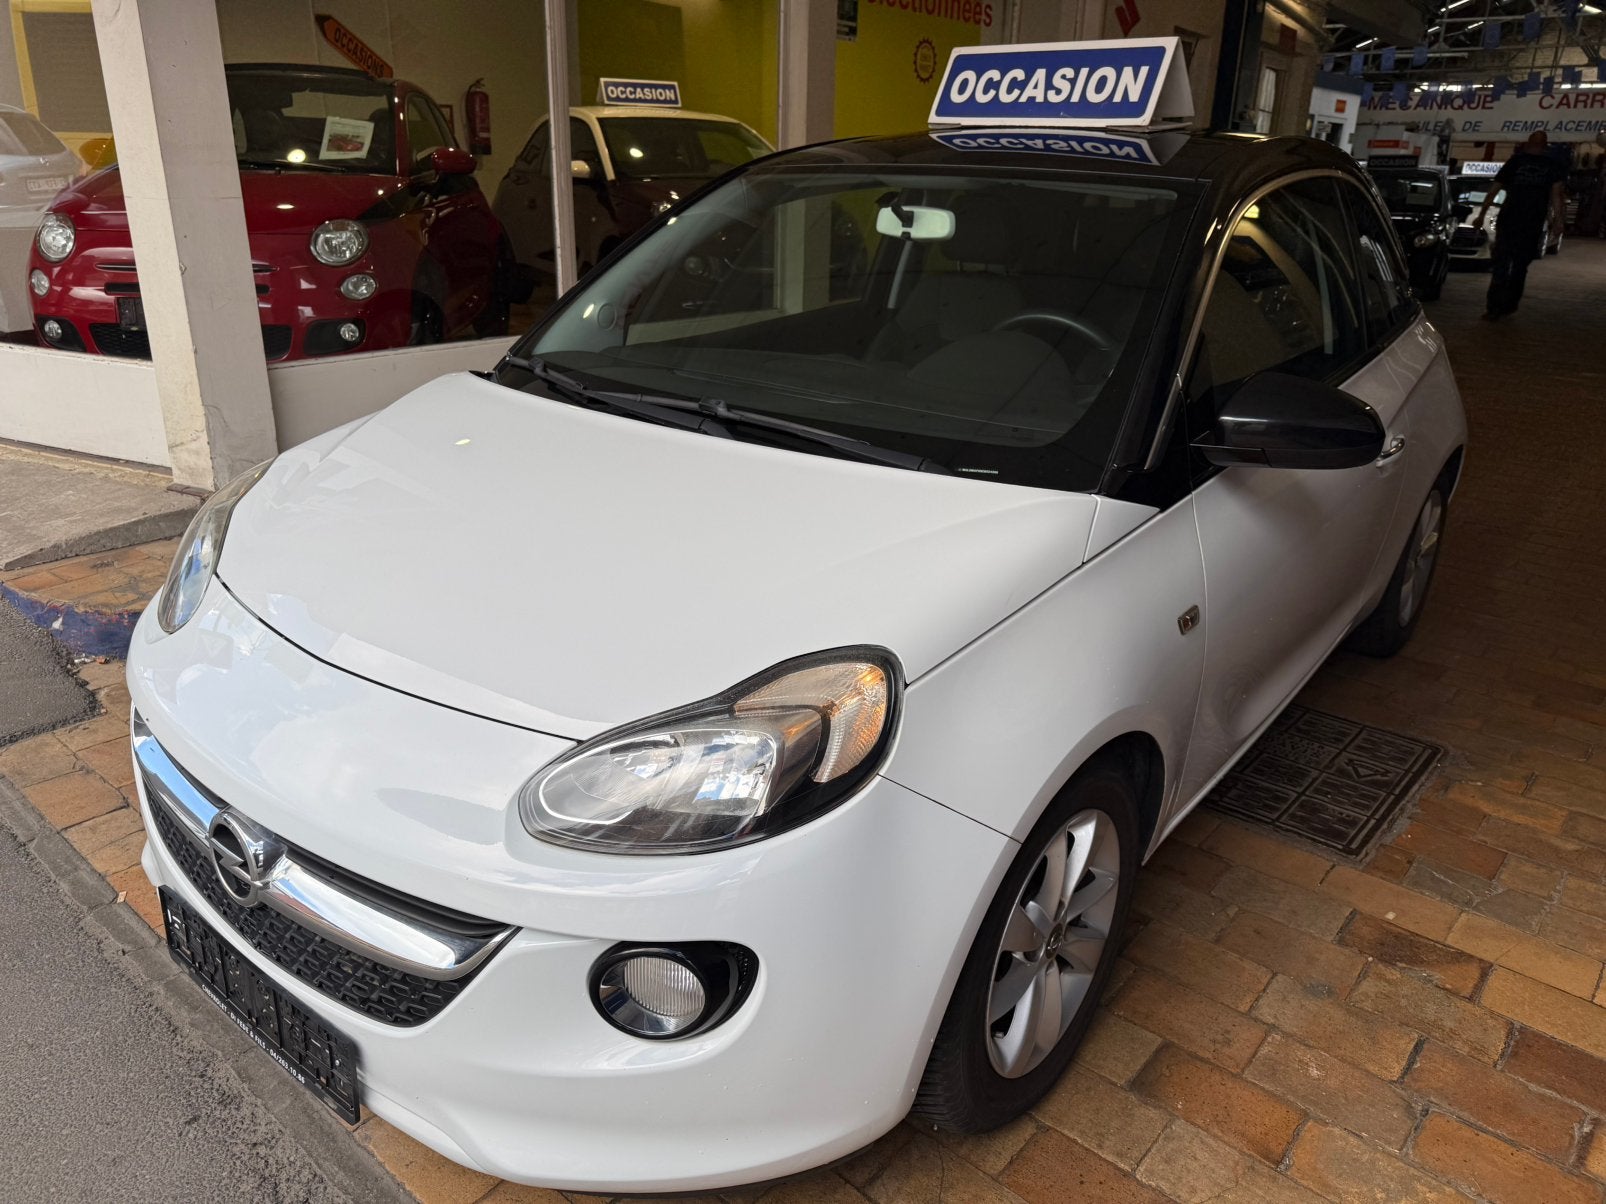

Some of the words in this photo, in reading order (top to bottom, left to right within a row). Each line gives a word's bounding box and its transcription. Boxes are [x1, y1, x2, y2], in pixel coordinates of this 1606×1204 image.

[335, 27, 384, 78] OCCASIONS
[607, 86, 676, 101] OCCASION
[950, 66, 1149, 104] OCCASION
[1462, 120, 1482, 132] DE
[1370, 158, 1416, 167] OCCASION
[201, 984, 227, 1012] CHEVROLET
[254, 1034, 266, 1050] FILS
